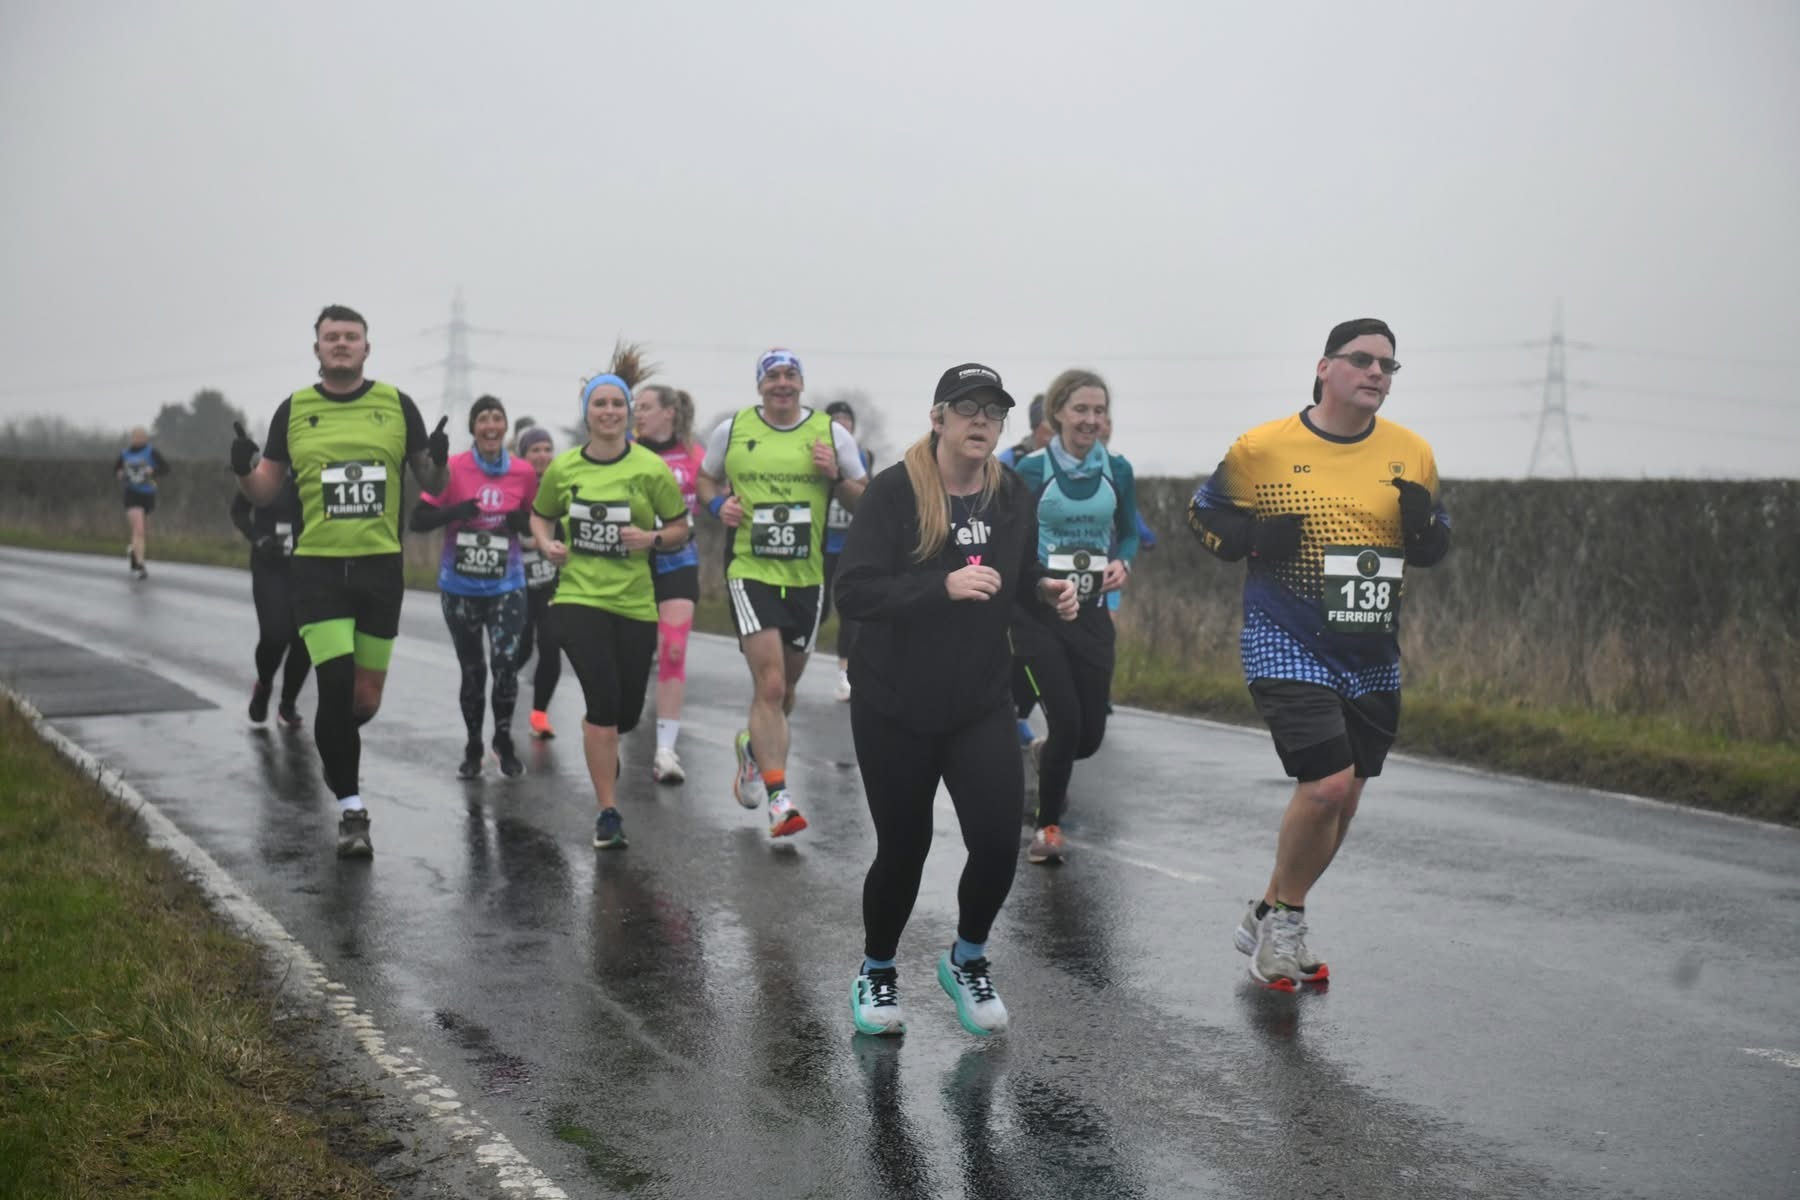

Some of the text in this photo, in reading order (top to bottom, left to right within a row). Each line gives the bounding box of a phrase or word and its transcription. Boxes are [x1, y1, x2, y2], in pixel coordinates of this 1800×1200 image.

[1293, 465, 1311, 474] DC
[334, 482, 376, 504] 116
[770, 485, 792, 496] RUN
[327, 503, 369, 513] FERRIBY
[579, 520, 619, 544] 528
[767, 525, 796, 546] 36
[573, 538, 611, 552] FERRIBY
[463, 547, 499, 567] 303
[1340, 579, 1392, 611] 138
[1327, 610, 1383, 624] FERRIBY
